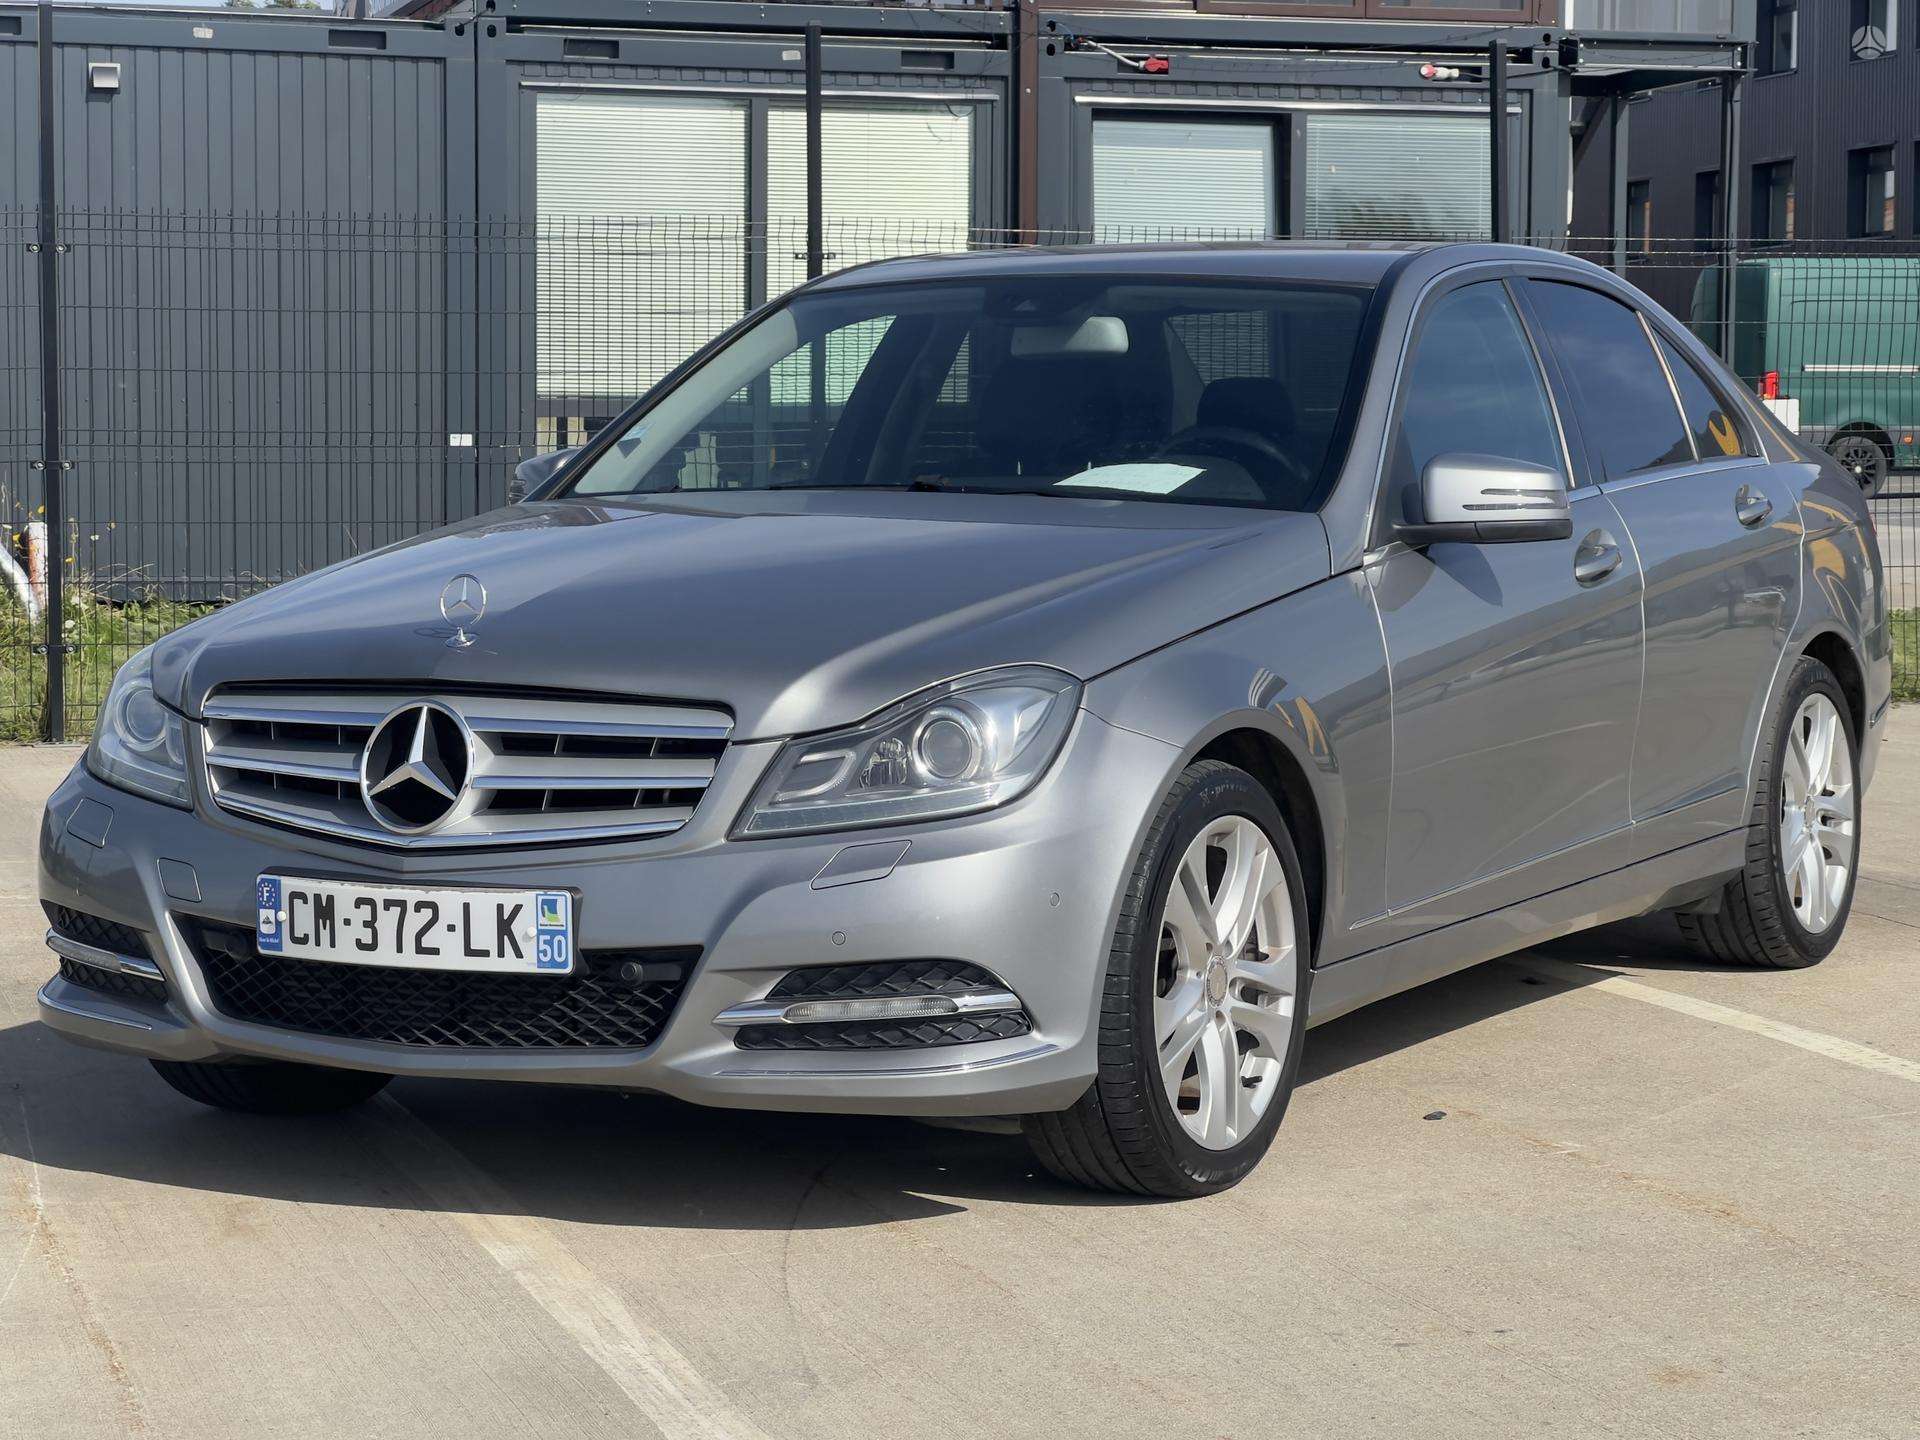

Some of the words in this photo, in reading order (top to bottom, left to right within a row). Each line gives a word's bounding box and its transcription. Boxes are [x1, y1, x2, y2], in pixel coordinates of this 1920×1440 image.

[263, 887, 270, 902] F
[288, 890, 524, 959] CM-372-LK
[538, 935, 566, 963] 50
